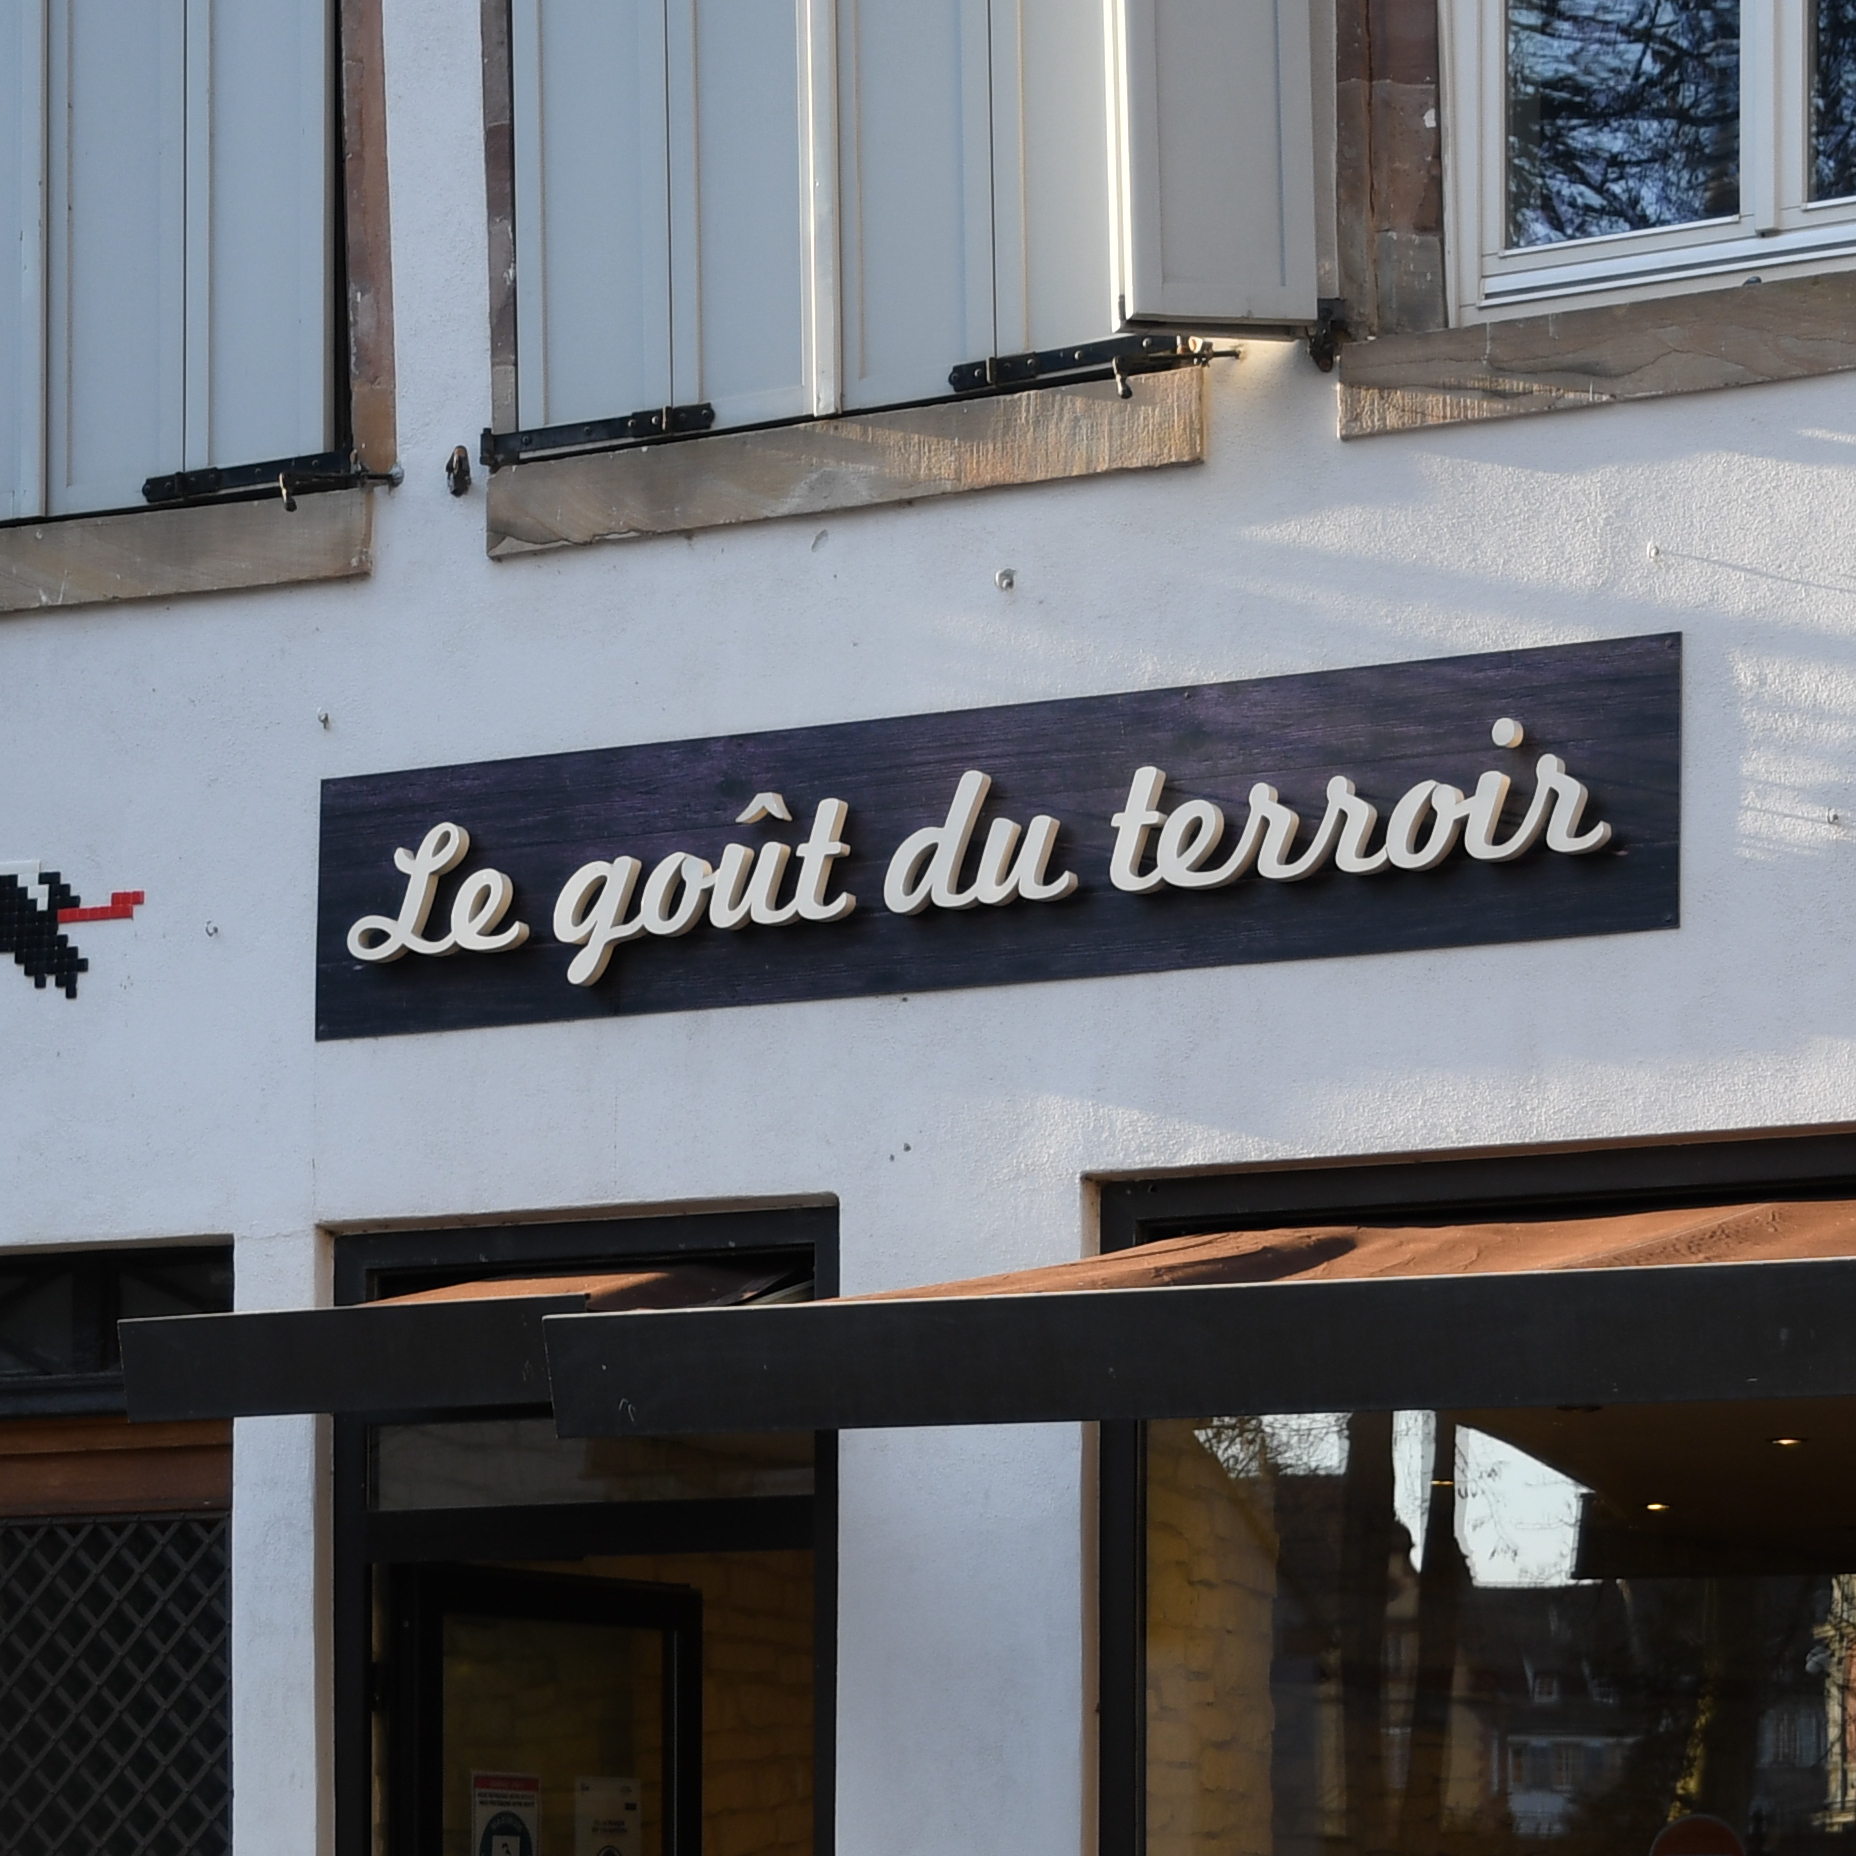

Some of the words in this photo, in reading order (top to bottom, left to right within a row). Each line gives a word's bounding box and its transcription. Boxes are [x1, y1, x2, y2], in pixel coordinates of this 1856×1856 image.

[347, 821, 531, 963] Le
[552, 791, 857, 986] goût
[884, 770, 1078, 914] du
[1110, 717, 1612, 894] terroir
